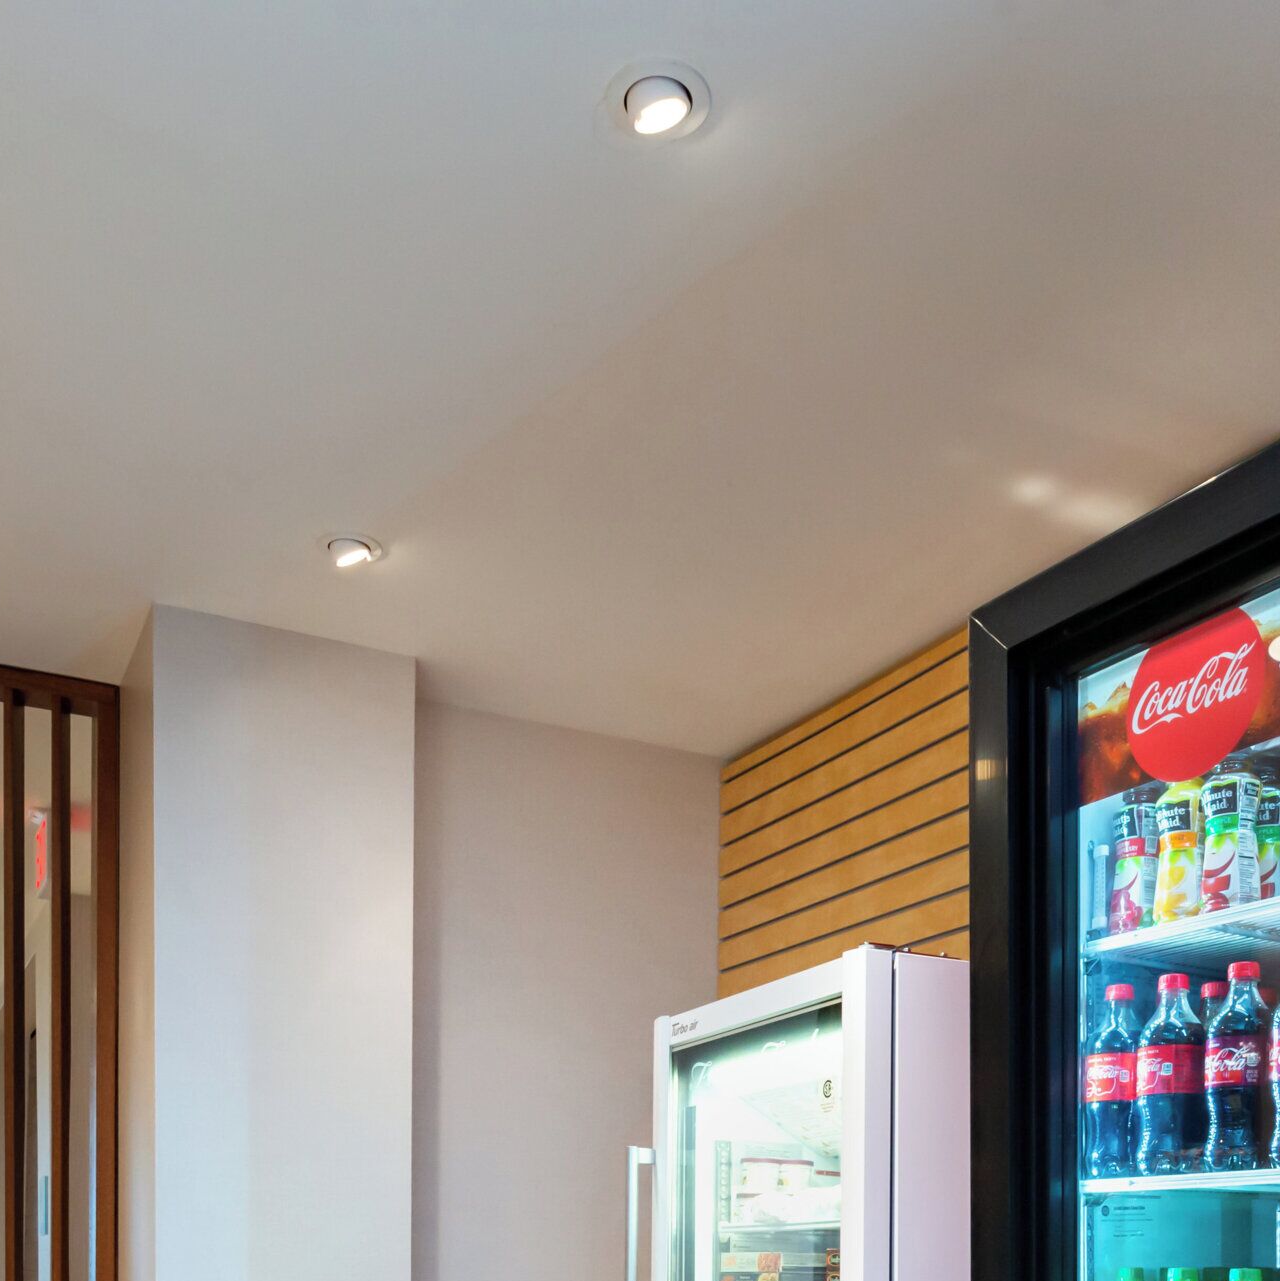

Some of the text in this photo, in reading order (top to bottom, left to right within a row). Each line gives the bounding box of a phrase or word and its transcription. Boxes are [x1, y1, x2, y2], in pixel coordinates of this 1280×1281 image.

[1131, 638, 1257, 735] Coca-Cola
[671, 1020, 698, 1037] Turbo air
